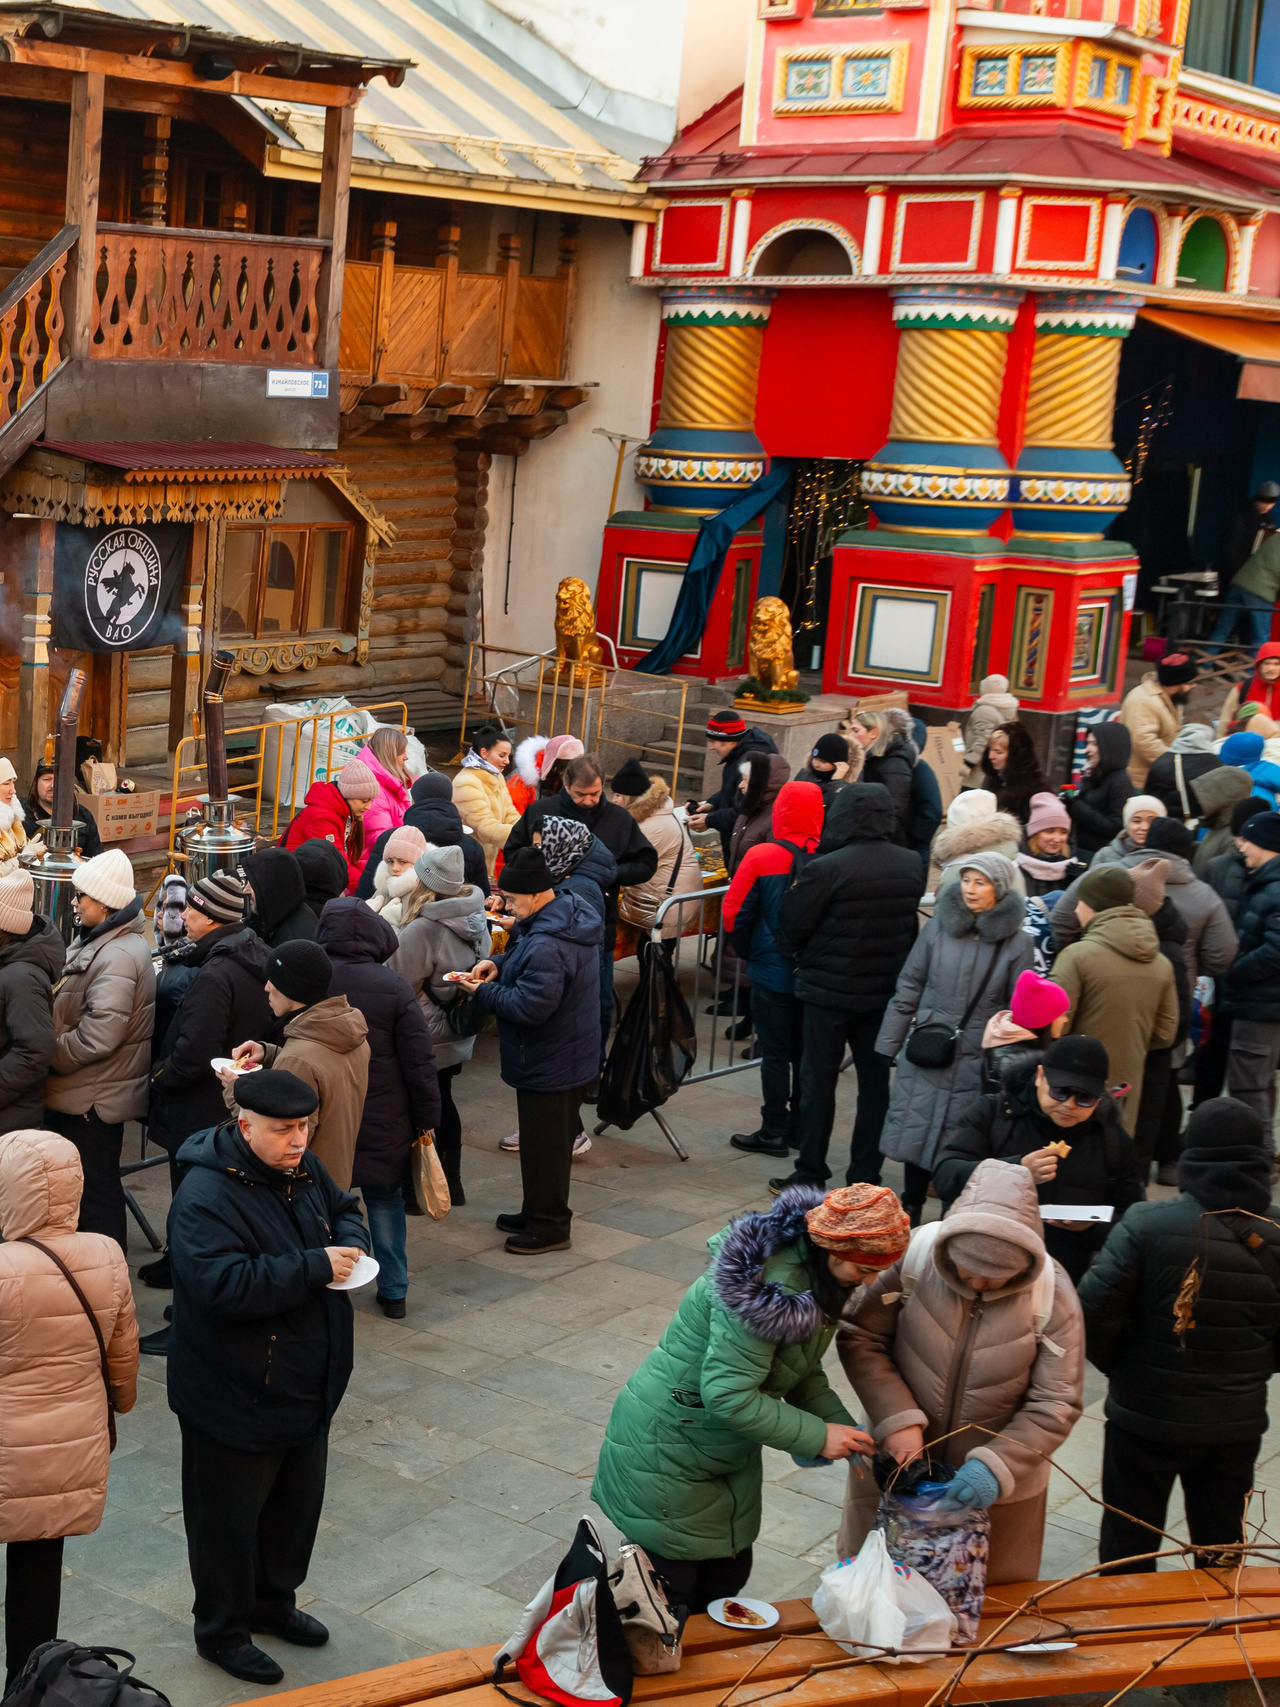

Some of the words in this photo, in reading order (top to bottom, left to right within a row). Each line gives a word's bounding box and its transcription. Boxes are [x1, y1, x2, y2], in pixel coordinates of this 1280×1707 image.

[88, 533, 125, 586] РУССКАЯ
[127, 533, 159, 586] ОБЩИНА
[105, 624, 132, 640] ВАО
